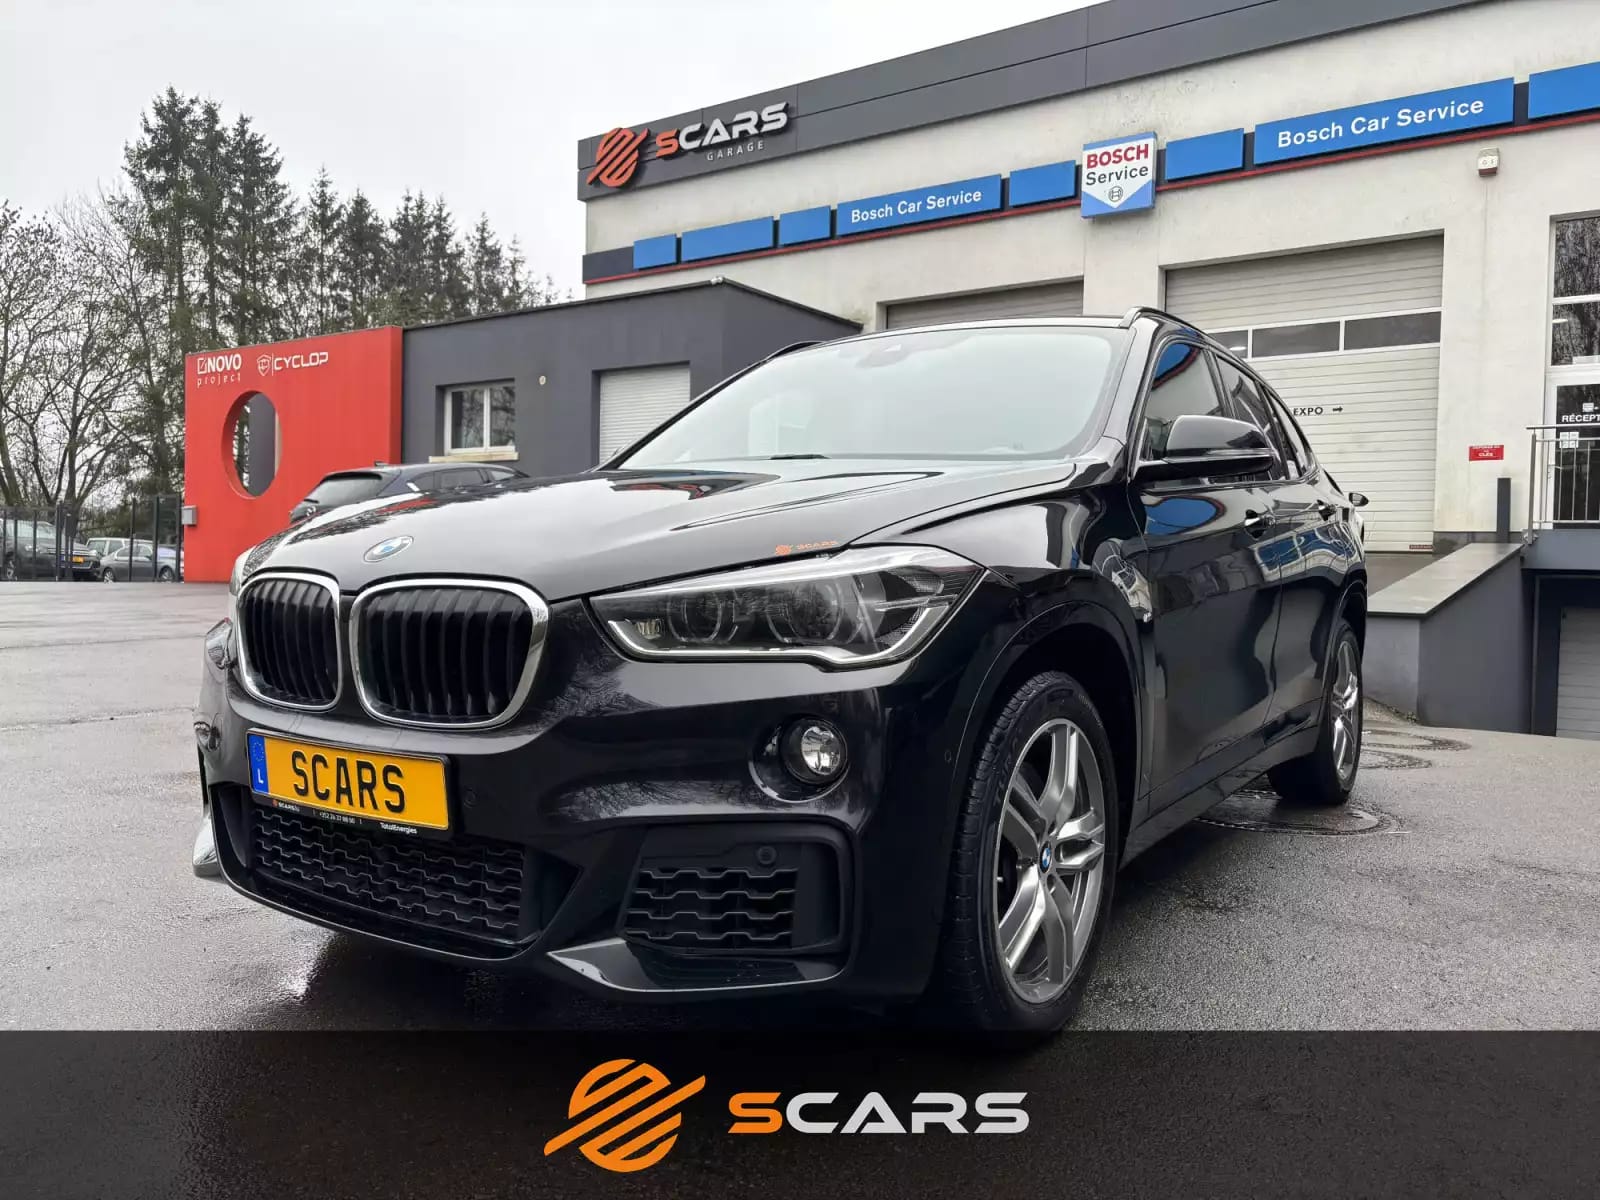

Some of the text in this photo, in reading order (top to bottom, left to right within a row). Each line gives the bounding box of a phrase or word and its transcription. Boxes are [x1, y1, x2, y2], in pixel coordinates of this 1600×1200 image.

[655, 101, 789, 157] SCARS
[1277, 99, 1485, 148] Bosch Car Service
[706, 139, 765, 161] GARAGE
[1086, 143, 1149, 169] BOSCH
[1085, 165, 1149, 186] Service
[851, 189, 982, 223] Bosch Car Service
[274, 351, 329, 371] CYCLOP
[197, 372, 241, 388] project
[1293, 406, 1324, 416] EXPO
[256, 750, 406, 813] L SCARS
[380, 821, 418, 834] TotalEnergies
